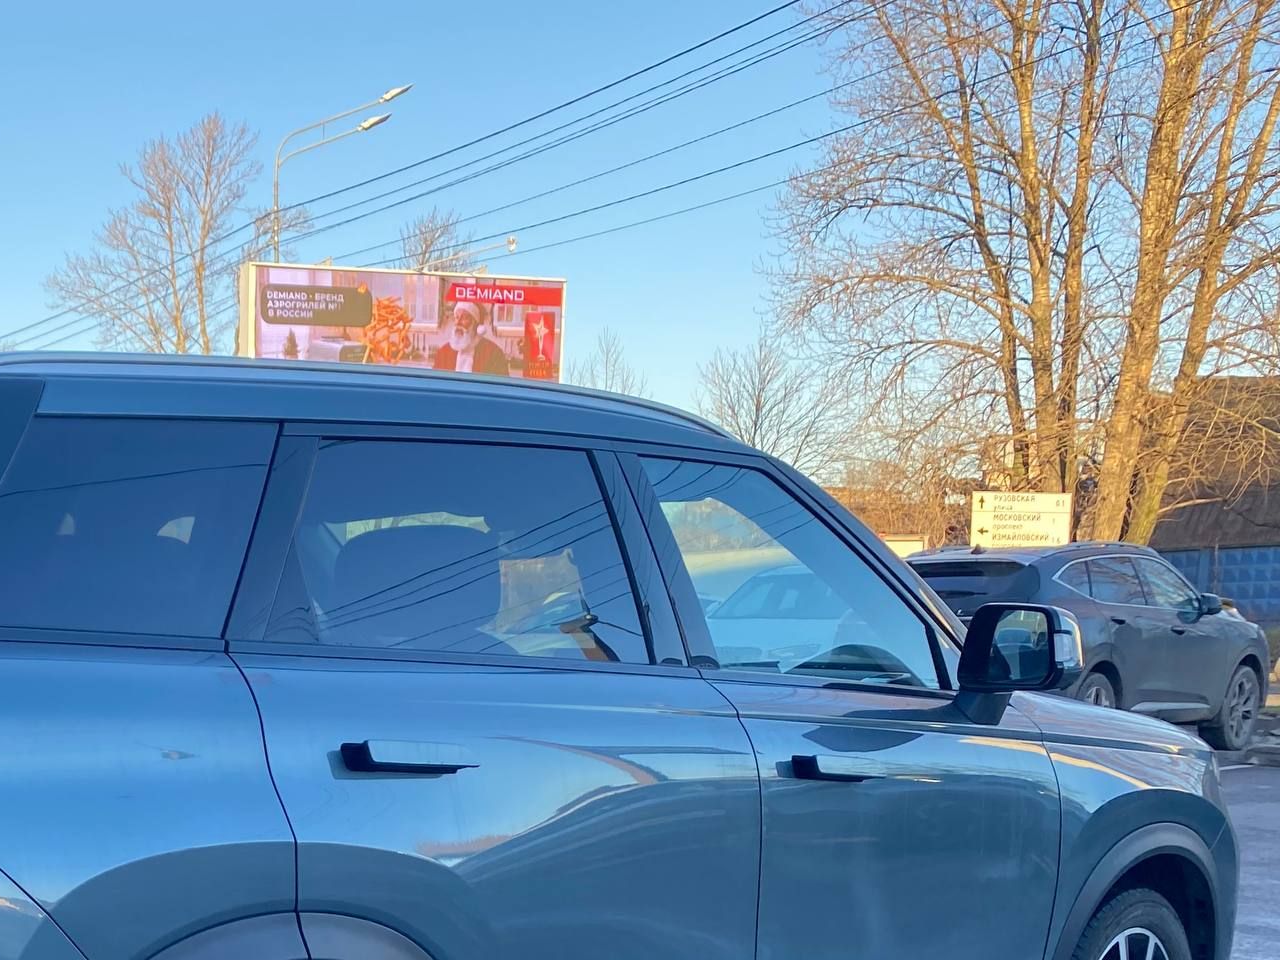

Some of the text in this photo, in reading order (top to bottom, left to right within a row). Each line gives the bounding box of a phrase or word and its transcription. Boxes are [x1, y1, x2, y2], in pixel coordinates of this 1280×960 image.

[266, 291, 344, 303] DEMIAND БРЕНД
[267, 300, 325, 309] АЭРОГРИЛЕЙ
[268, 309, 313, 318] В РОССИИ
[994, 494, 1036, 502] РУЗОВСКАЯ
[993, 513, 1041, 521] МОСКОВСКИЙ
[992, 533, 1049, 541] ИЗМАЙЛОВСКИЙ
